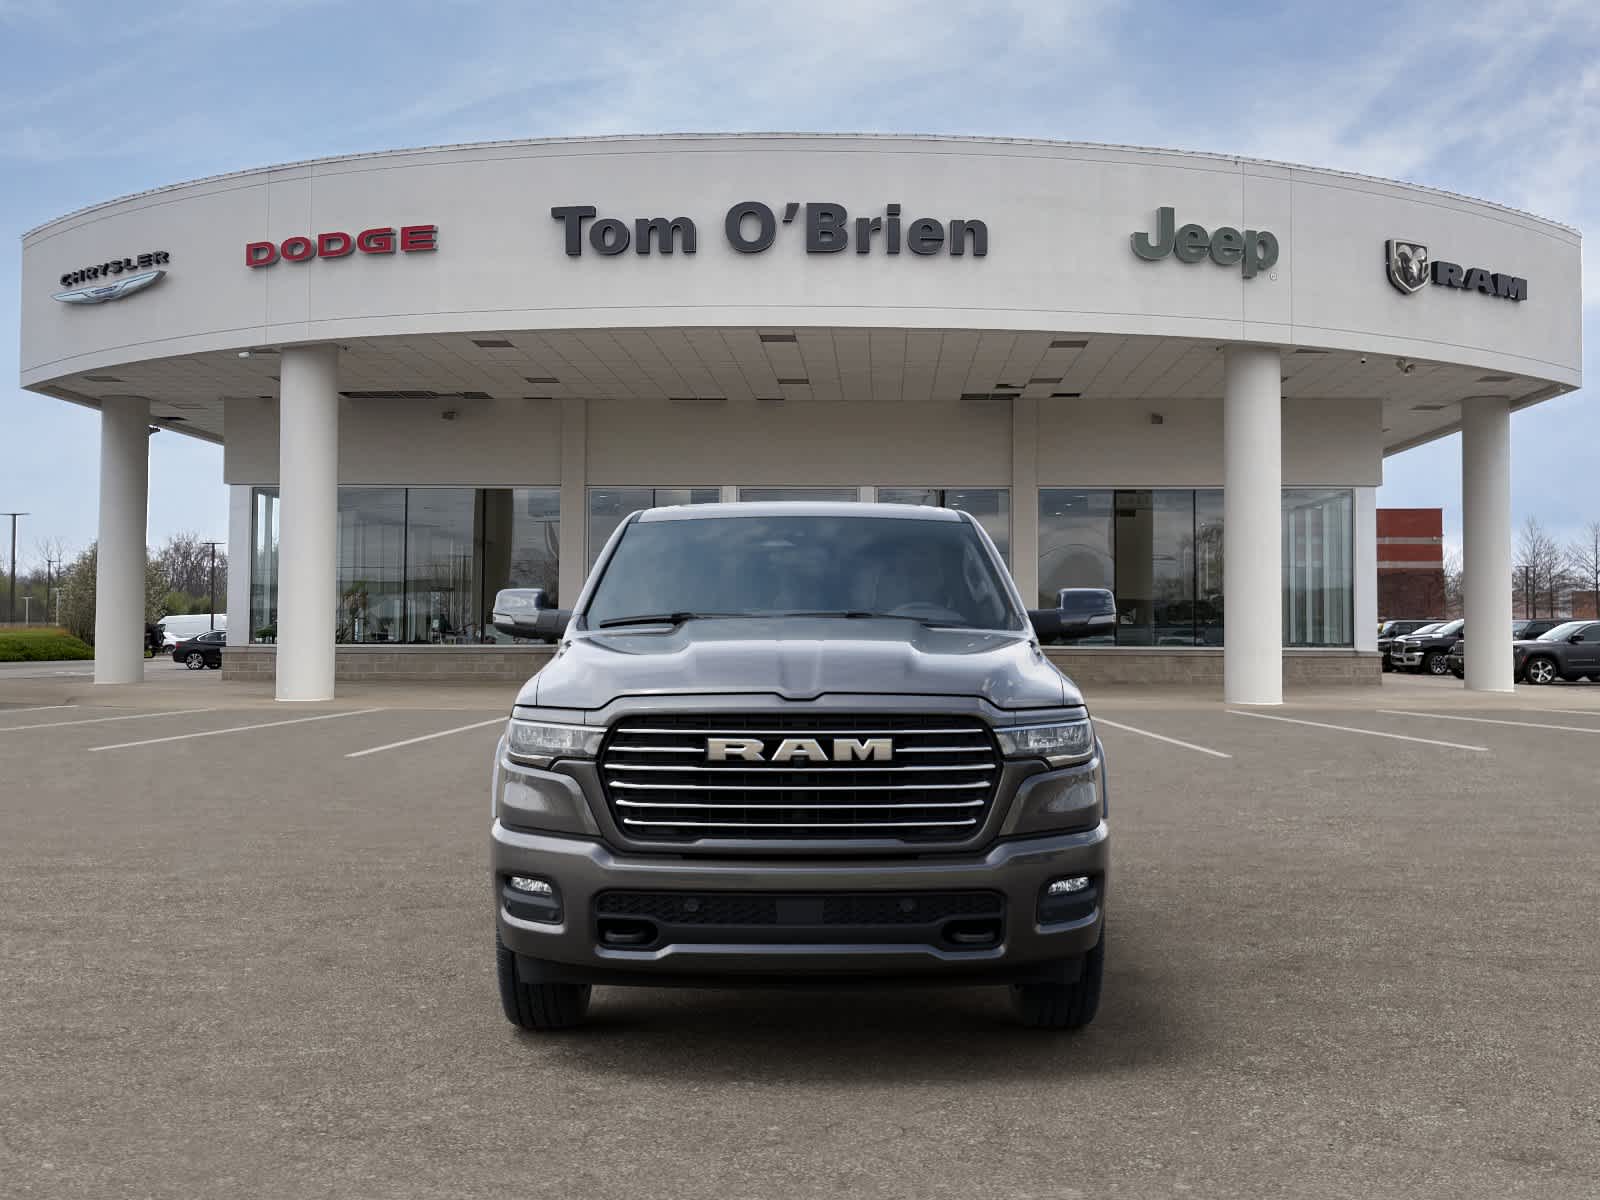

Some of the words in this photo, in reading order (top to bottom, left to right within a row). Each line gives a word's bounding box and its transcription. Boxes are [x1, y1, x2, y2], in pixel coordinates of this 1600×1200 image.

[245, 225, 438, 269] DODGE
[551, 205, 697, 257] Tom
[725, 201, 989, 257] O'Brien
[1130, 206, 1280, 279] Jeep
[60, 250, 171, 288] CHRYSLER
[1431, 260, 1528, 301] RAM
[707, 737, 893, 761] RAM
